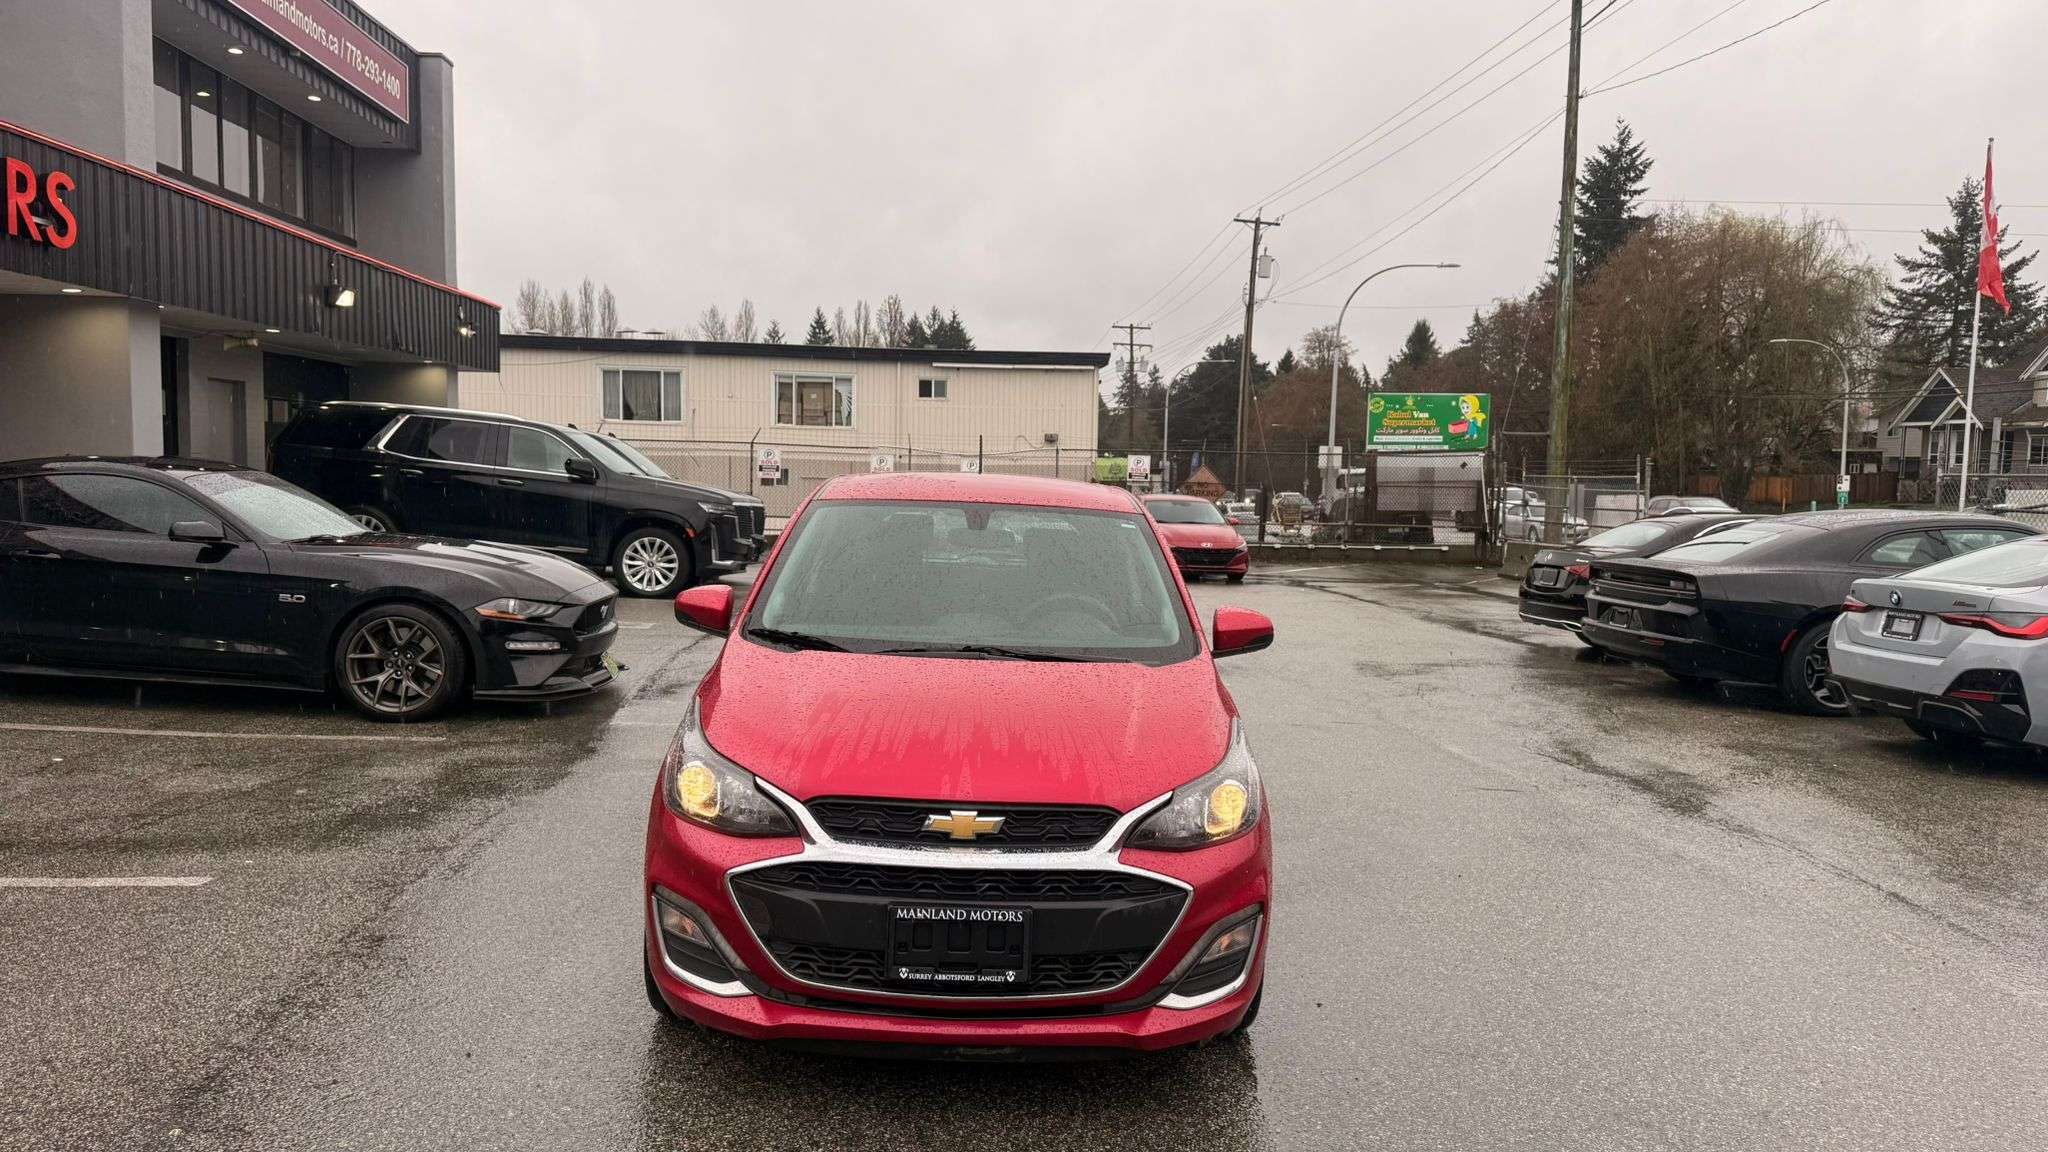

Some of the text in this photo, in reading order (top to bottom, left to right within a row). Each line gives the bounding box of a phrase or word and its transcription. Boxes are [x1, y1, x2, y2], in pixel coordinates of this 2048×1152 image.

[346, 41, 400, 99] 778-293-1400
[6, 156, 77, 249] RS
[1383, 418, 1436, 427] Supermarket
[896, 908, 1023, 922] MAINLAND MOTORS
[908, 972, 1006, 983] SURREY ABBOTSFORD LANGLEY
